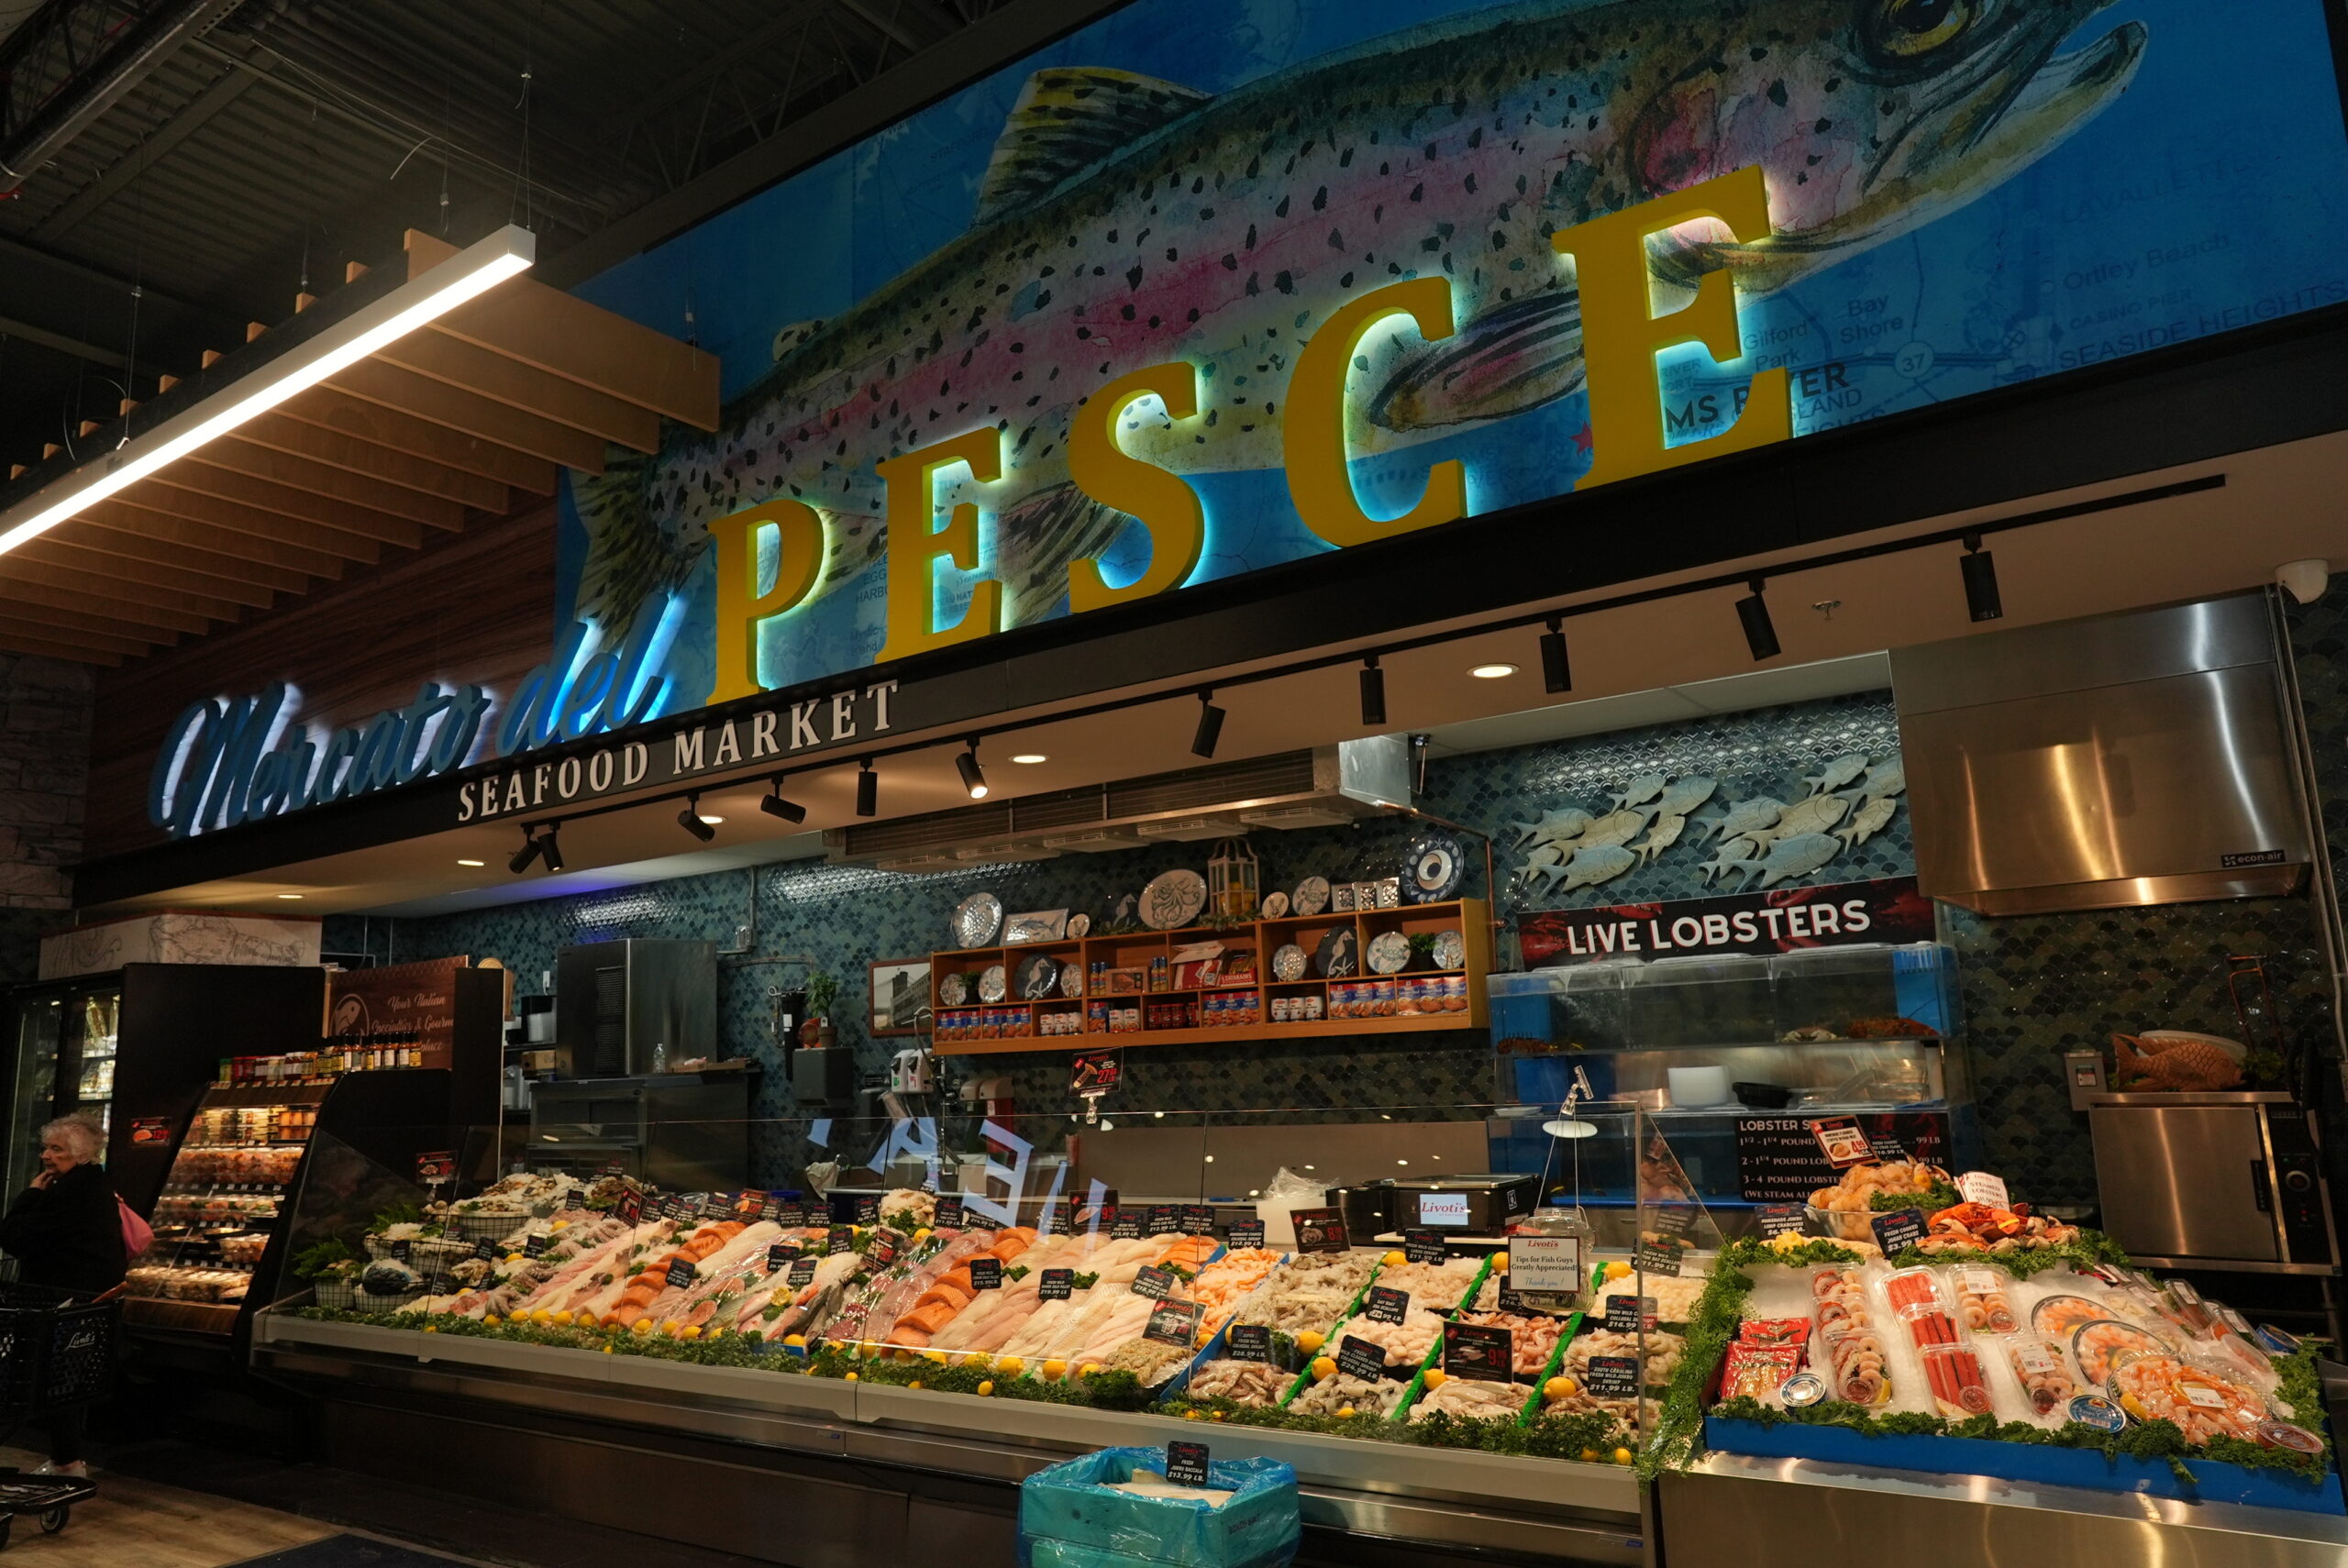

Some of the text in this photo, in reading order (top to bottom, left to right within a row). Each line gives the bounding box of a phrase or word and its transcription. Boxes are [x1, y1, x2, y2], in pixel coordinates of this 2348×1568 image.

[2064, 232, 2230, 291] Ortley Beach
[1847, 294, 1889, 318] Bay
[2070, 288, 2195, 330] CASINO PIER
[1841, 315, 1905, 346] Shore
[2060, 281, 2347, 370] SEASIDE HEIGHTS
[1743, 320, 1809, 351] Gilford
[1755, 348, 1801, 371] Park
[1902, 353, 1927, 373] 37
[1797, 388, 1863, 420] LAND
[1665, 394, 1719, 435] MS
[705, 164, 1793, 707] PESCE
[147, 591, 681, 837] Mercato del
[458, 679, 900, 823] SEAFOOD MARKET
[1567, 900, 1872, 955] LIVE LOBSTERS
[415, 992, 447, 1008] Italian
[424, 1014, 455, 1032] Gourm
[1740, 1120, 1811, 1132] LOBSTER S
[1780, 1137, 1816, 1146] POUND
[1773, 1156, 1809, 1165] POUND
[1809, 1156, 1829, 1165] LOB
[1767, 1176, 1802, 1184] POUND
[1804, 1176, 1841, 1184] LOBSTE
[1744, 1190, 1763, 1199] (WE
[1765, 1189, 1795, 1198] STEAM
[1421, 1201, 1468, 1215] Livoti's
[1883, 1215, 1909, 1226] Livoti's
[1884, 1223, 1919, 1238] FRESH COOKED
[1527, 1240, 1559, 1248] Livoti's
[1516, 1256, 1531, 1264] Tips
[1556, 1255, 1574, 1265] Guys
[1511, 1263, 1578, 1274] Greatly Appreciated!
[1525, 1276, 1545, 1286] Thank
[1600, 1360, 1626, 1368] Livoti's
[1589, 1384, 1635, 1393] $11.99 LB.
[1167, 1471, 1205, 1482] $13.99 LB.
